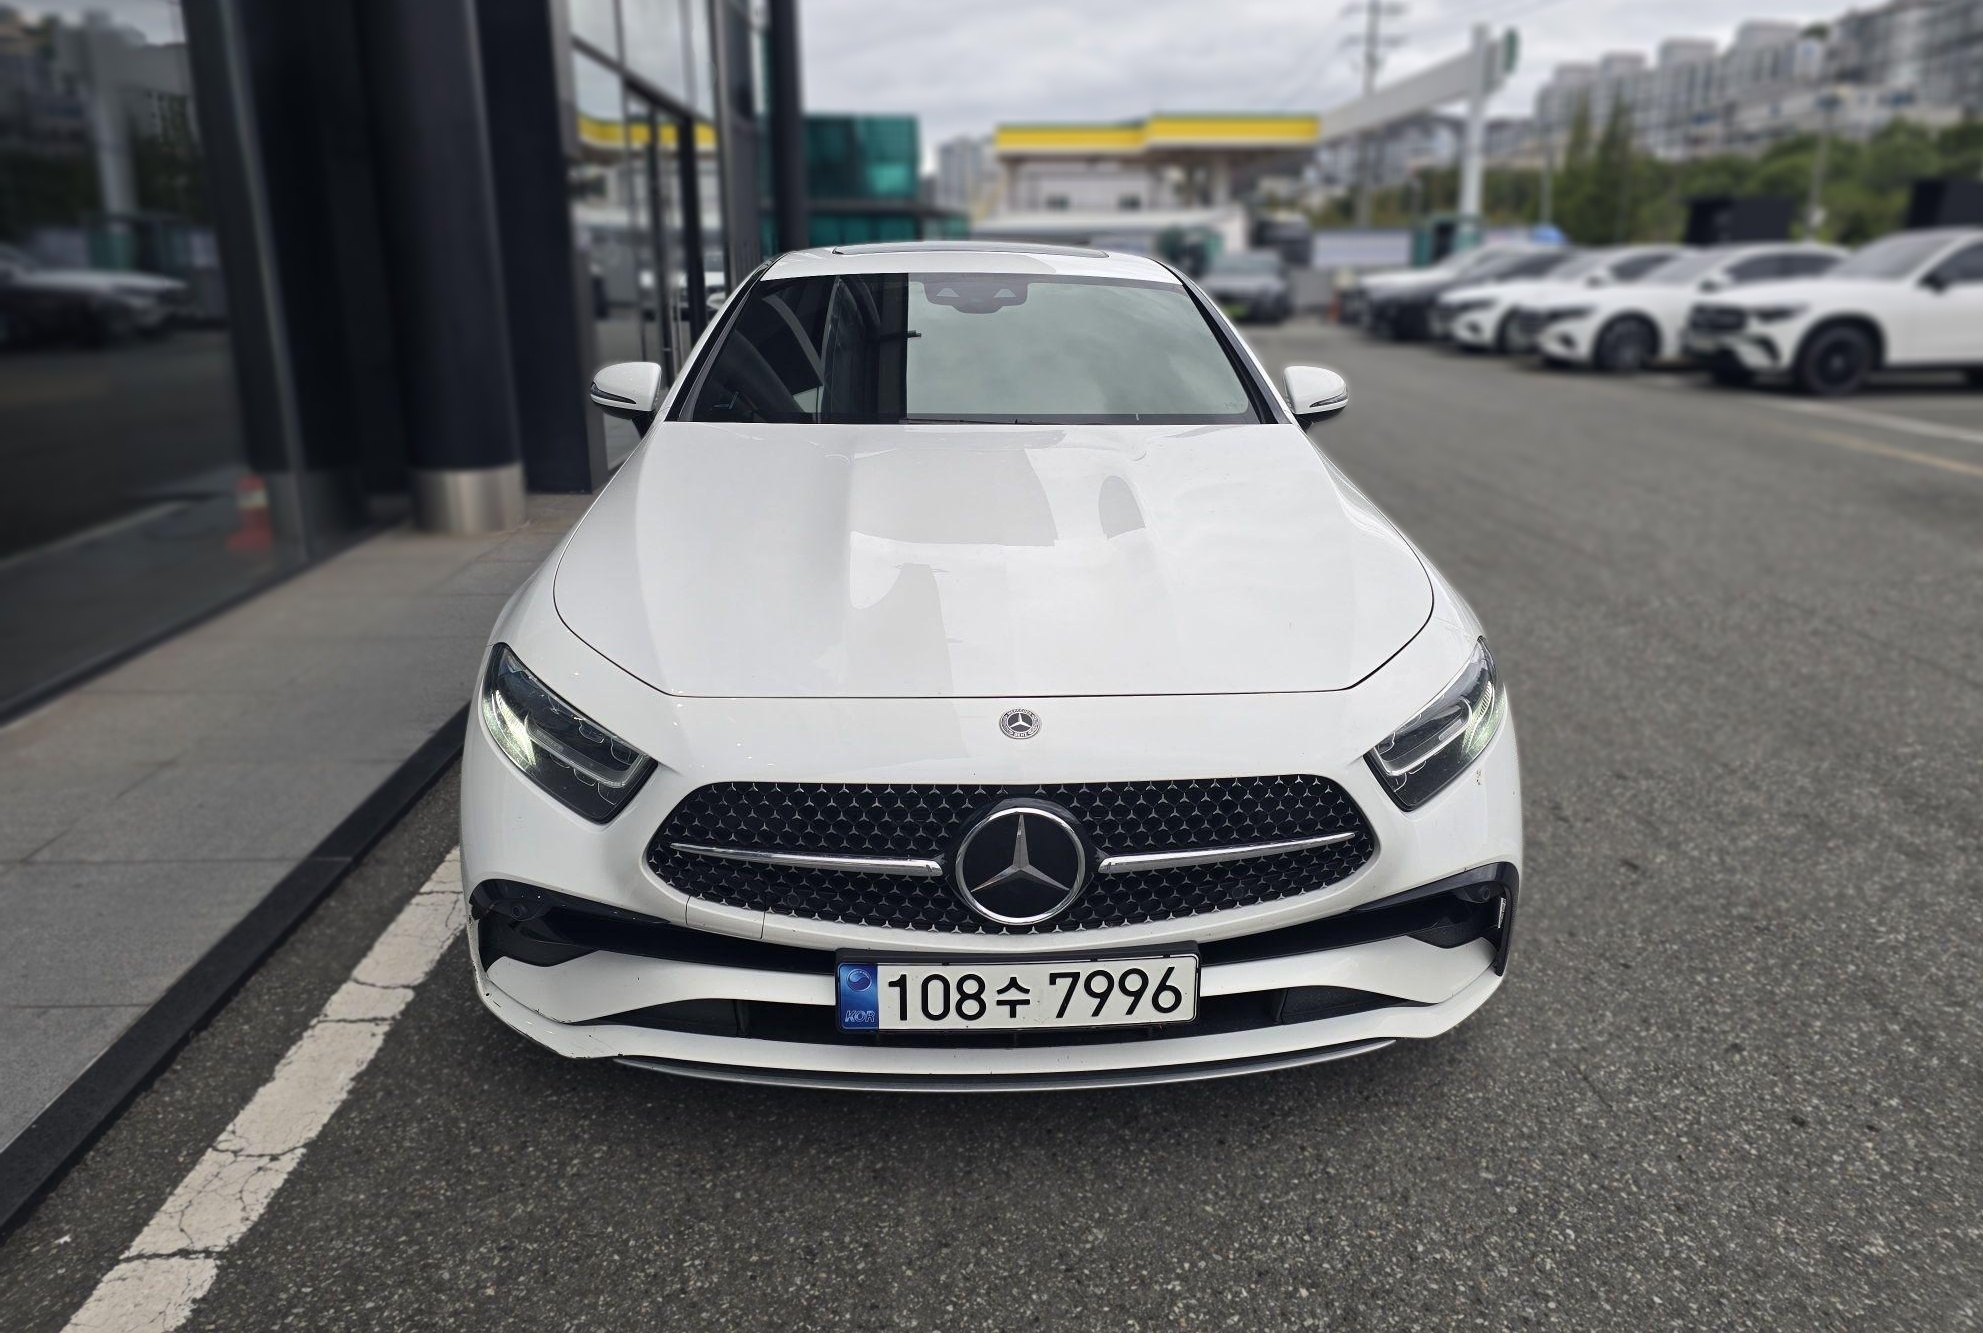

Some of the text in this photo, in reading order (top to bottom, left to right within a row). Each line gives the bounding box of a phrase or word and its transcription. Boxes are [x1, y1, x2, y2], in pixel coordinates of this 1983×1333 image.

[887, 966, 1183, 1022] 108수 7996
[845, 1009, 876, 1023] KOR
